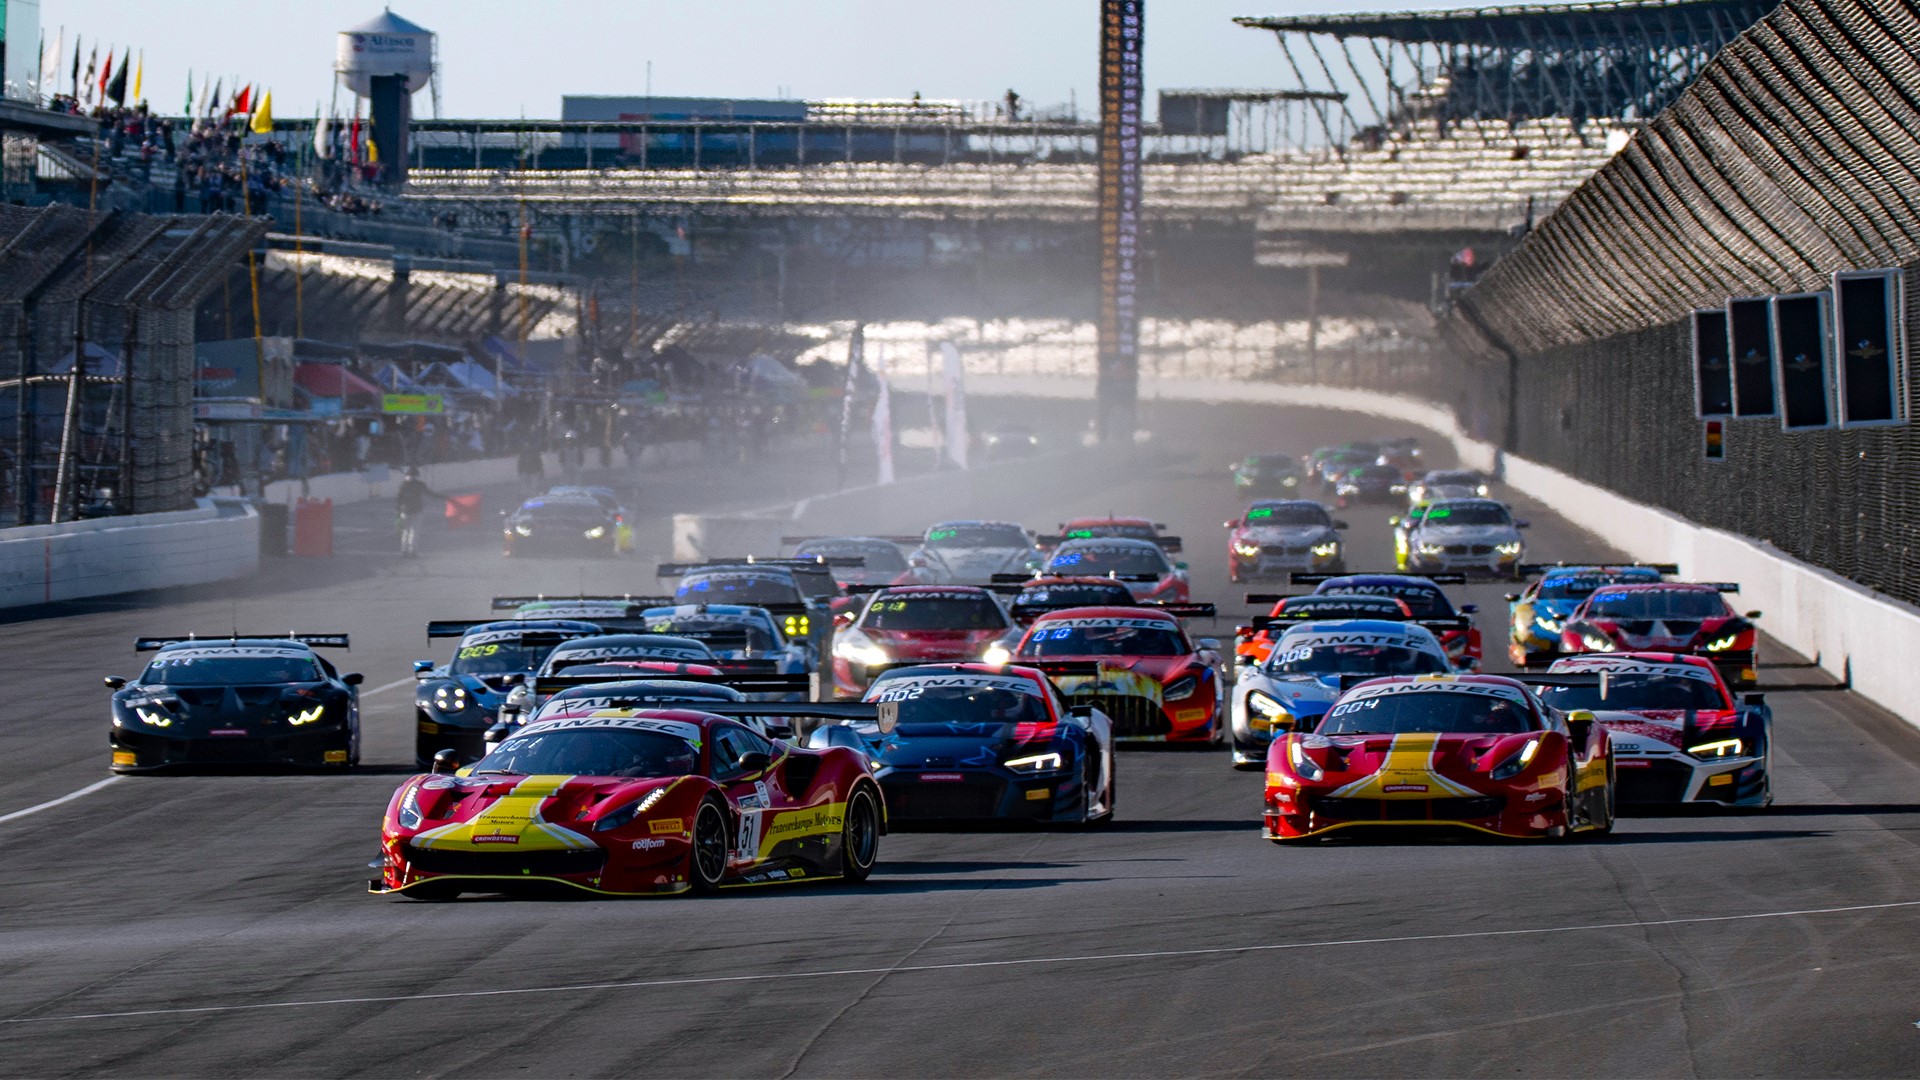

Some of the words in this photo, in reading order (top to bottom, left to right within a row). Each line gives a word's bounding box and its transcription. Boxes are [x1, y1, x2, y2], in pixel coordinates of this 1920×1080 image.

[877, 592, 986, 601] FANATEC
[1326, 585, 1436, 598] FANATEC
[1284, 602, 1397, 613] FANATEC
[1045, 619, 1165, 630] FANATEC
[1291, 635, 1425, 649] FANATEC
[167, 648, 296, 658] FANATEC
[458, 644, 499, 660] 009
[567, 647, 695, 660] FANATEC
[885, 678, 1031, 692] FANATEC
[1356, 684, 1513, 698] FANATEC
[1331, 698, 1380, 717] 004
[521, 719, 685, 735] FANATEC
[814, 811, 842, 827] Motors
[652, 821, 681, 832] PIRELLI
[741, 814, 755, 850] 51
[632, 838, 666, 852] rotiform
